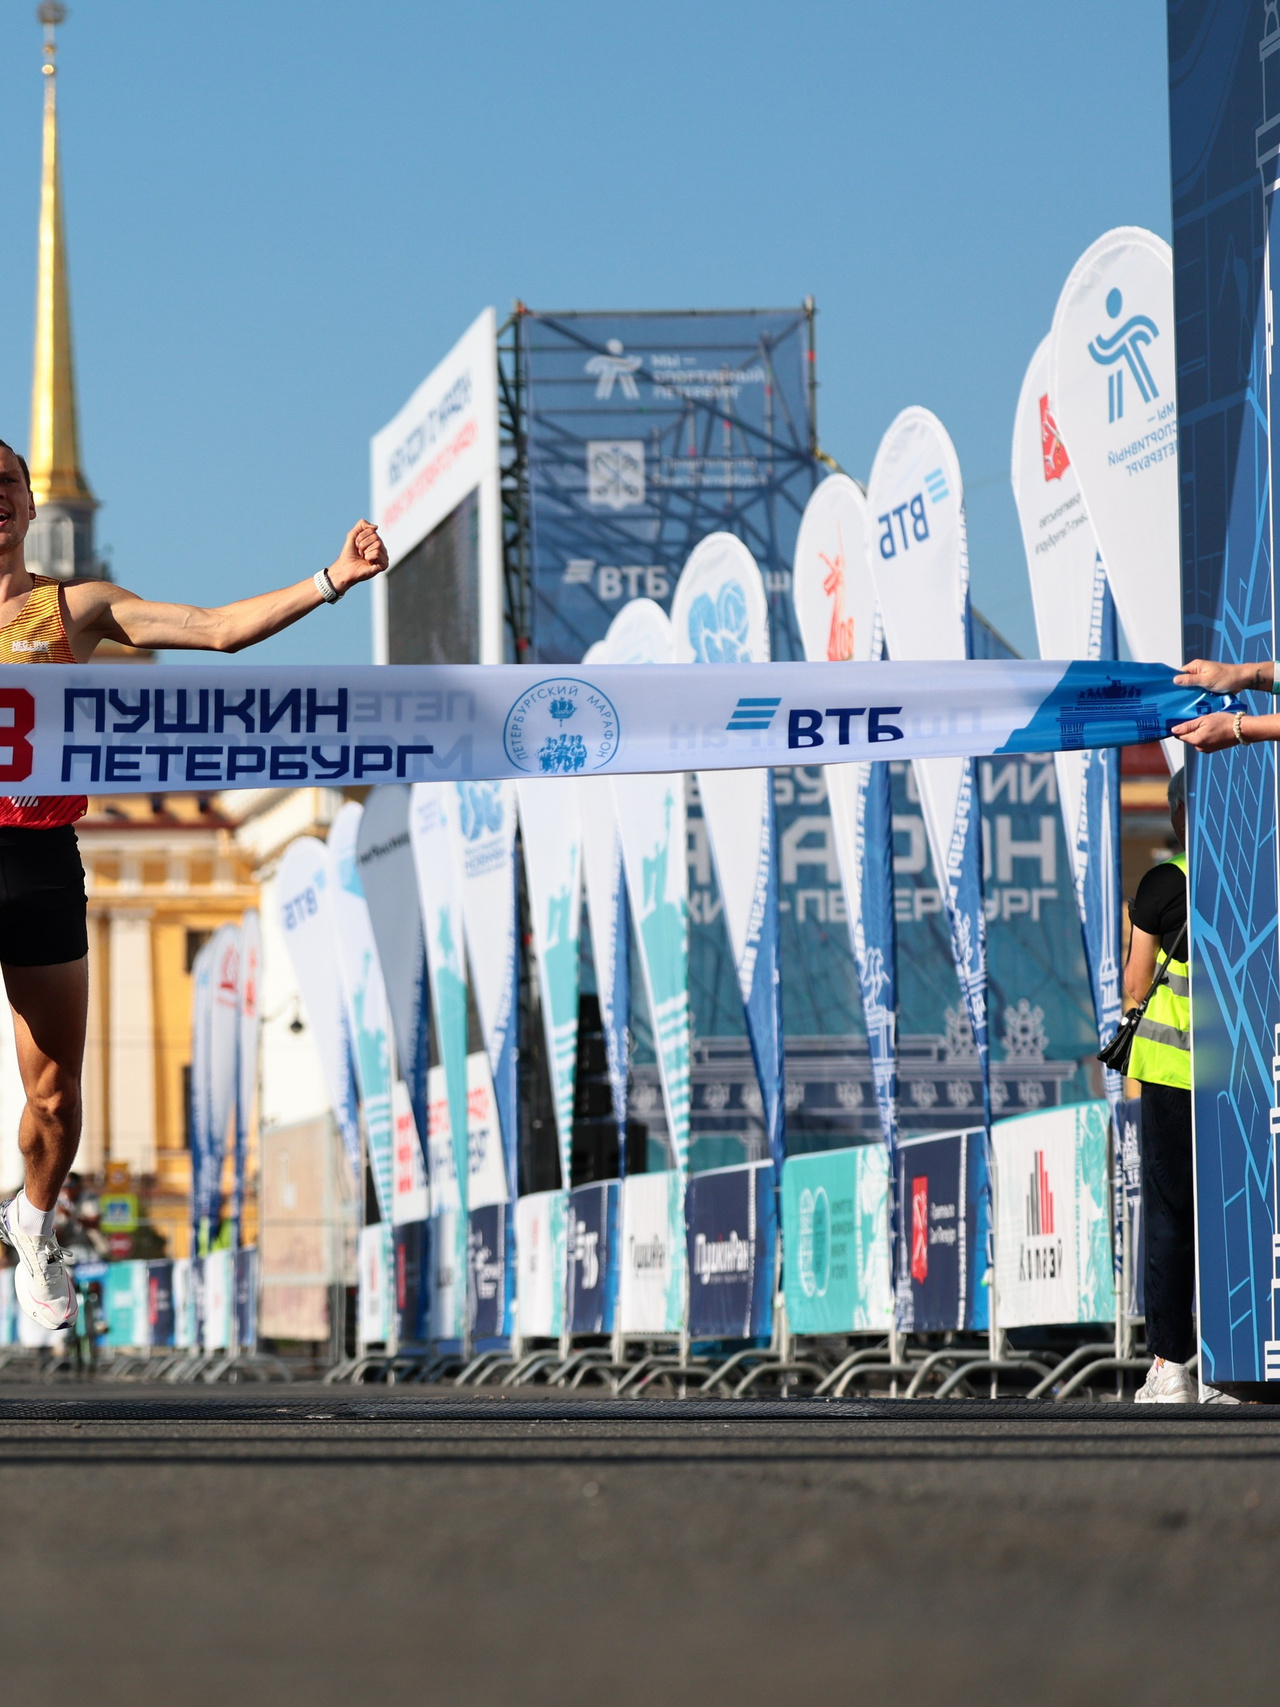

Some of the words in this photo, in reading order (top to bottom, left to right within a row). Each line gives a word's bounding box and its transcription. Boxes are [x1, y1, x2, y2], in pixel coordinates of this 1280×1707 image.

[597, 565, 669, 601] ВТБ
[64, 687, 349, 735] ПУШКИН
[510, 685, 579, 761] ПЕТЕРБУРГСКИЙ
[586, 694, 614, 759] МАРАФОН
[787, 706, 905, 750] ВТБ
[61, 744, 434, 783] ПЕТЕРБУРГ
